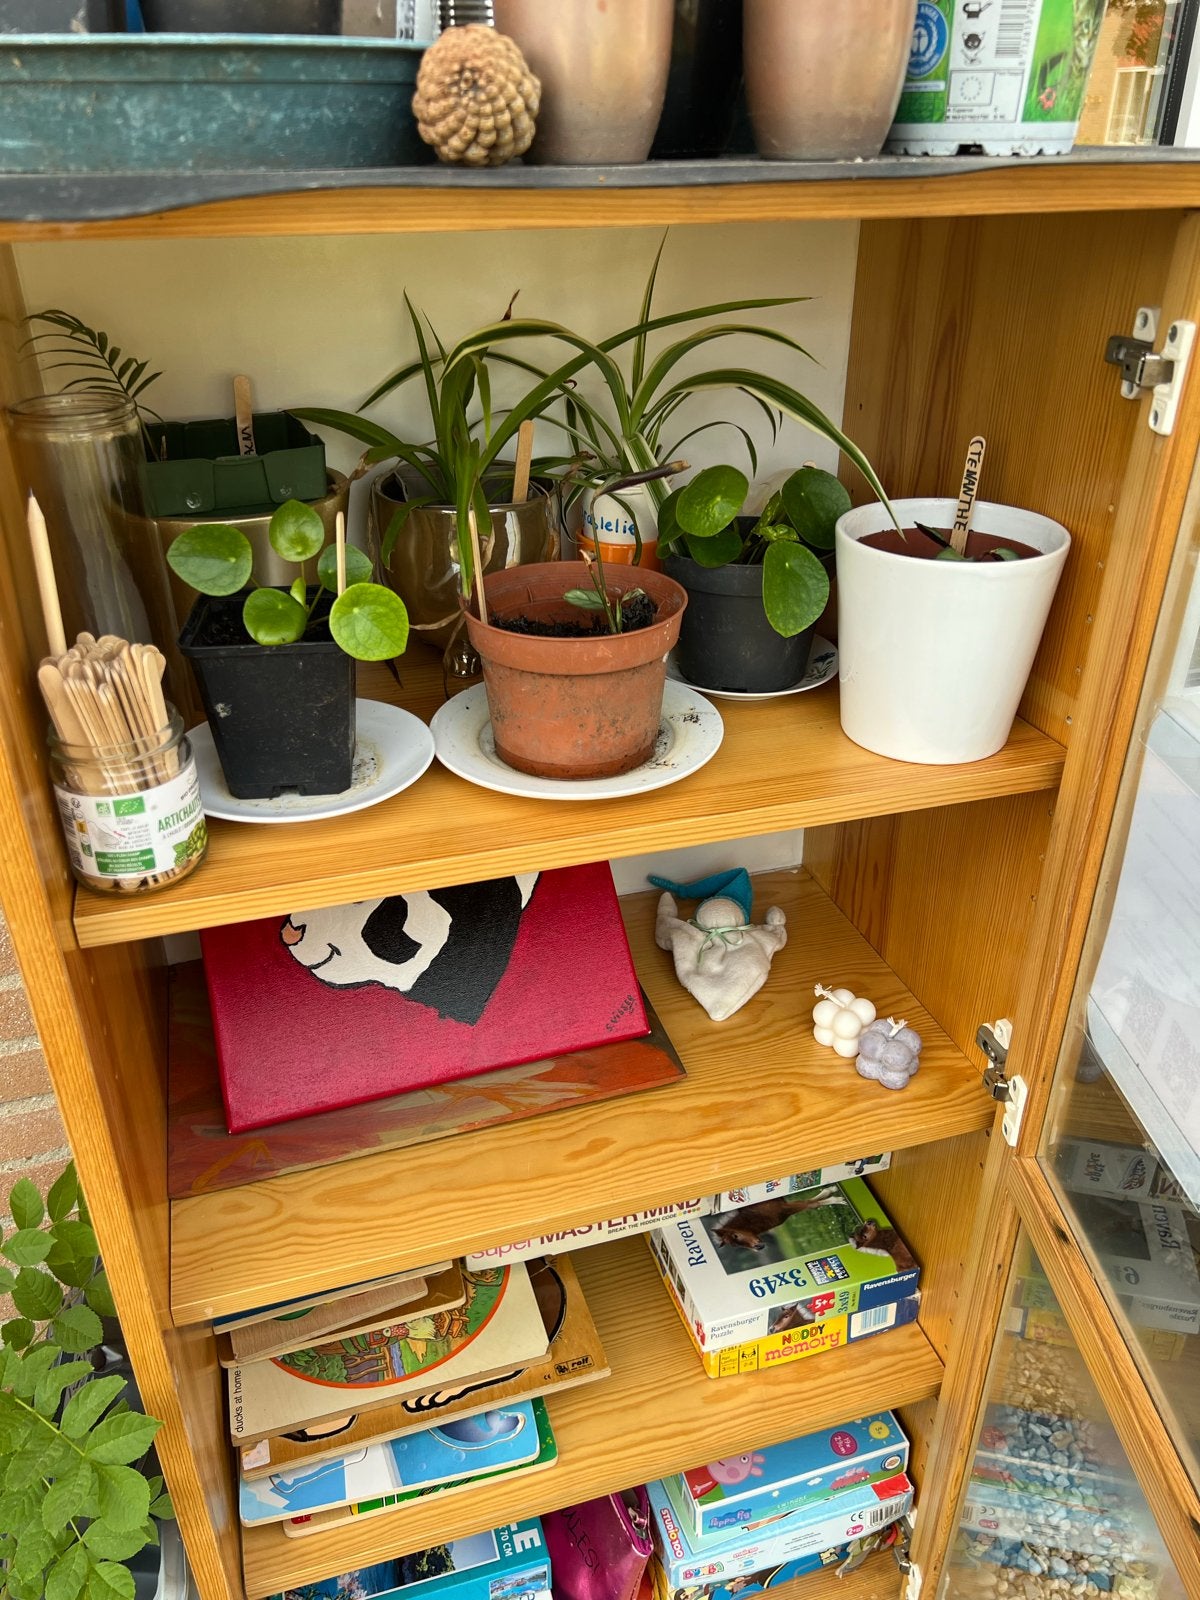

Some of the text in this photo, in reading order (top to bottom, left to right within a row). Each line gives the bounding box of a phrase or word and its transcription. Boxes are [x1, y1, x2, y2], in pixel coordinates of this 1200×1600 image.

[607, 1226, 627, 1235] BREAK
[628, 1222, 639, 1230] THE
[661, 1212, 677, 1221] CODE
[676, 1220, 707, 1267] Raven
[749, 1268, 807, 1298] 3x49
[863, 1271, 917, 1291] Ravensburger
[814, 1298, 827, 1309] 5+
[838, 1291, 849, 1314] 3x49
[710, 1329, 734, 1340] Puzzle
[711, 1315, 760, 1333] Ravensburger
[782, 1323, 826, 1346] NODDY
[764, 1331, 841, 1362] memory
[571, 1356, 589, 1368] rolf
[233, 1370, 242, 1394] home
[234, 1396, 243, 1404] at
[234, 1406, 244, 1433] ducks
[710, 1510, 752, 1528] Peppa Pig
[500, 1530, 513, 1557] 70 CM
